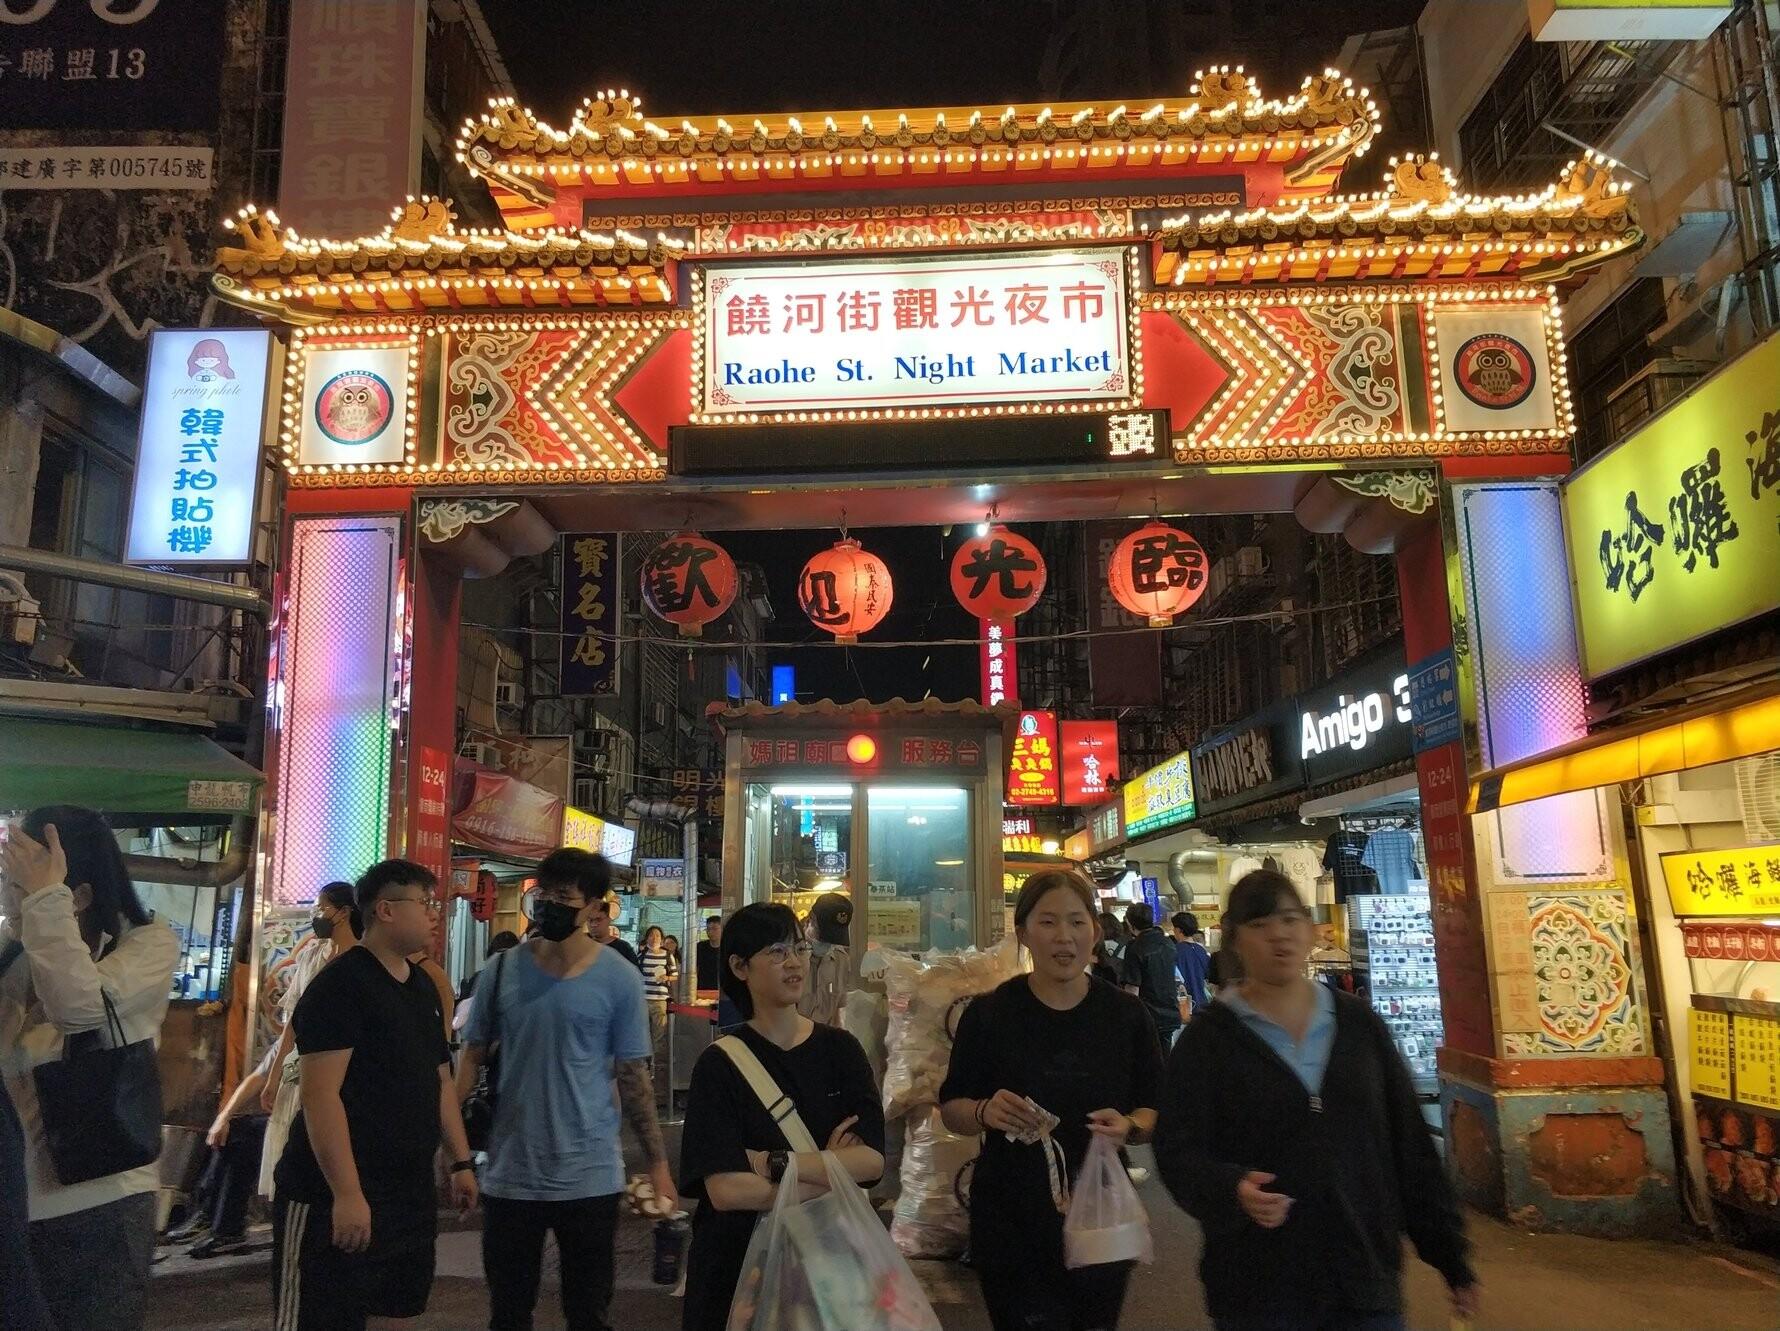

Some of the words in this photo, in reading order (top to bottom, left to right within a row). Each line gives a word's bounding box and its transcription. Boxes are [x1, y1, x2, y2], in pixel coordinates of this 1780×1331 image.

[725, 280, 1106, 338] 饒河街觀光夜市
[724, 359, 816, 386] Raohe
[836, 357, 874, 382] St.
[893, 352, 976, 384] Night
[998, 348, 1113, 376] Market
[166, 408, 225, 554] 韓式拍貼機
[960, 539, 1037, 599] 光
[1131, 534, 1204, 594] 臨
[901, 739, 981, 766] 服務台
[1301, 691, 1384, 759] Amigo
